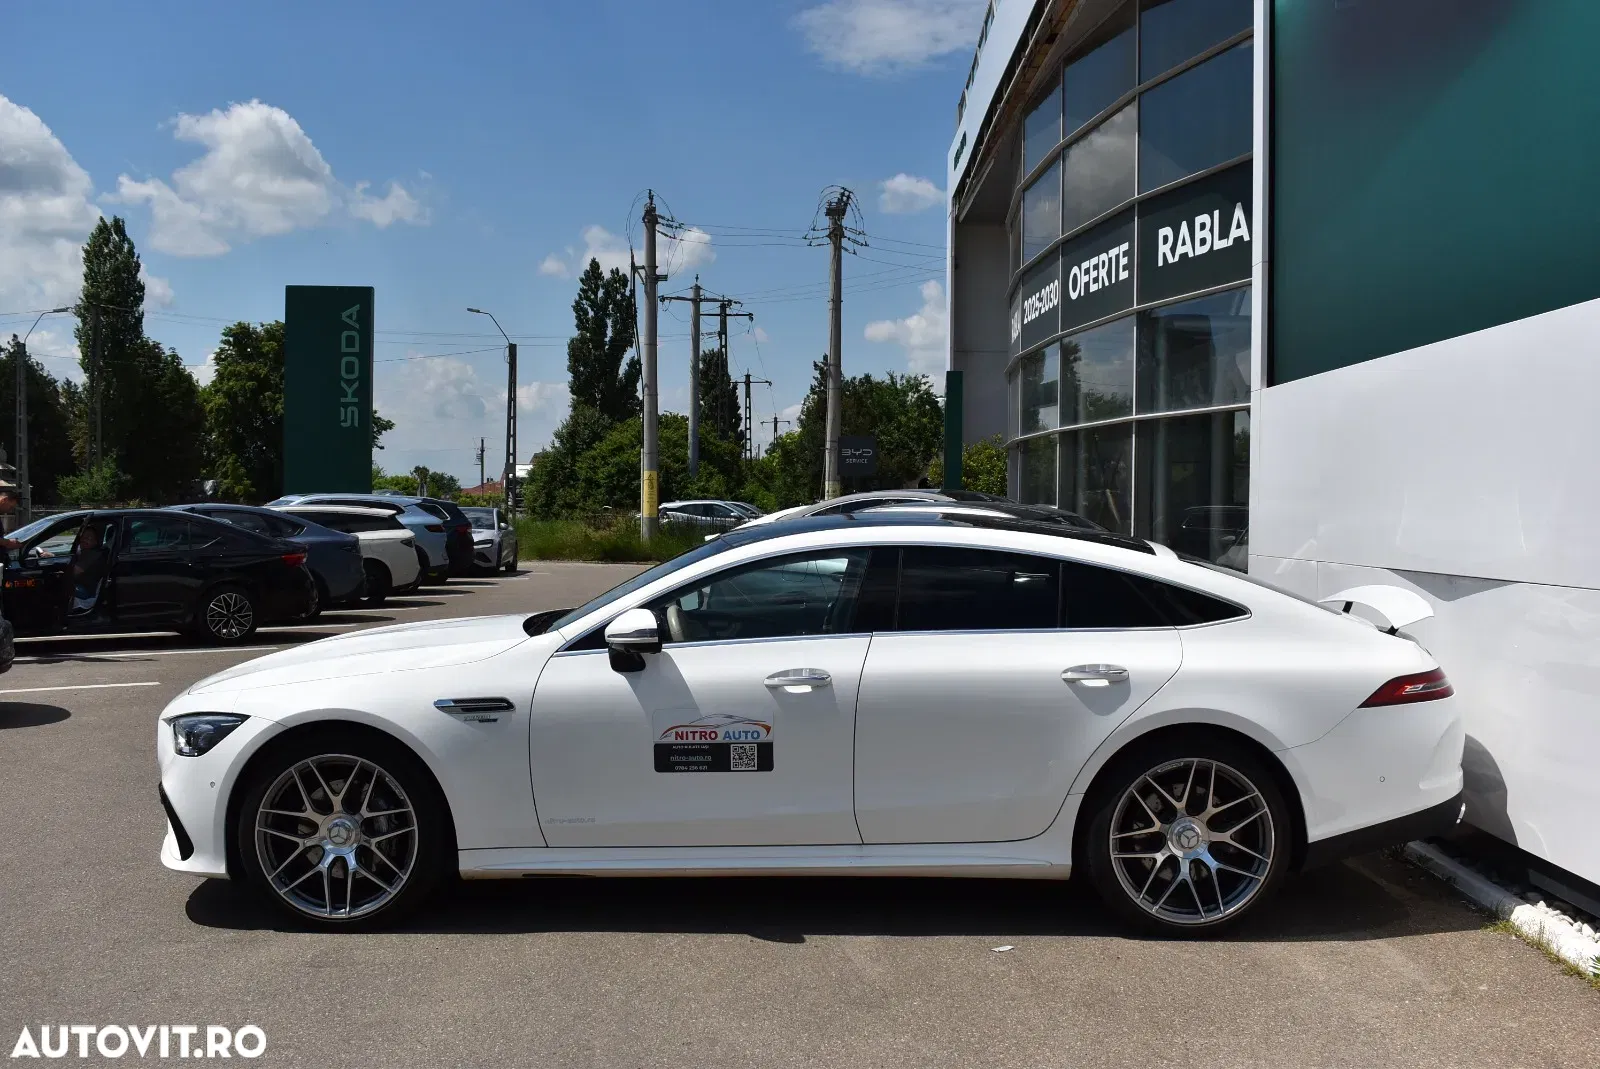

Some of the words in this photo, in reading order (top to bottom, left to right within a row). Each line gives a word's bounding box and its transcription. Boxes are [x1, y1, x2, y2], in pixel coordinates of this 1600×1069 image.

[1023, 278, 1059, 325] 2025-2030
[1068, 241, 1129, 300] OFERTE
[1157, 201, 1250, 267] RABLA
[841, 448, 873, 456] BYD
[674, 730, 719, 741] NITRO
[722, 730, 761, 741] AUTO
